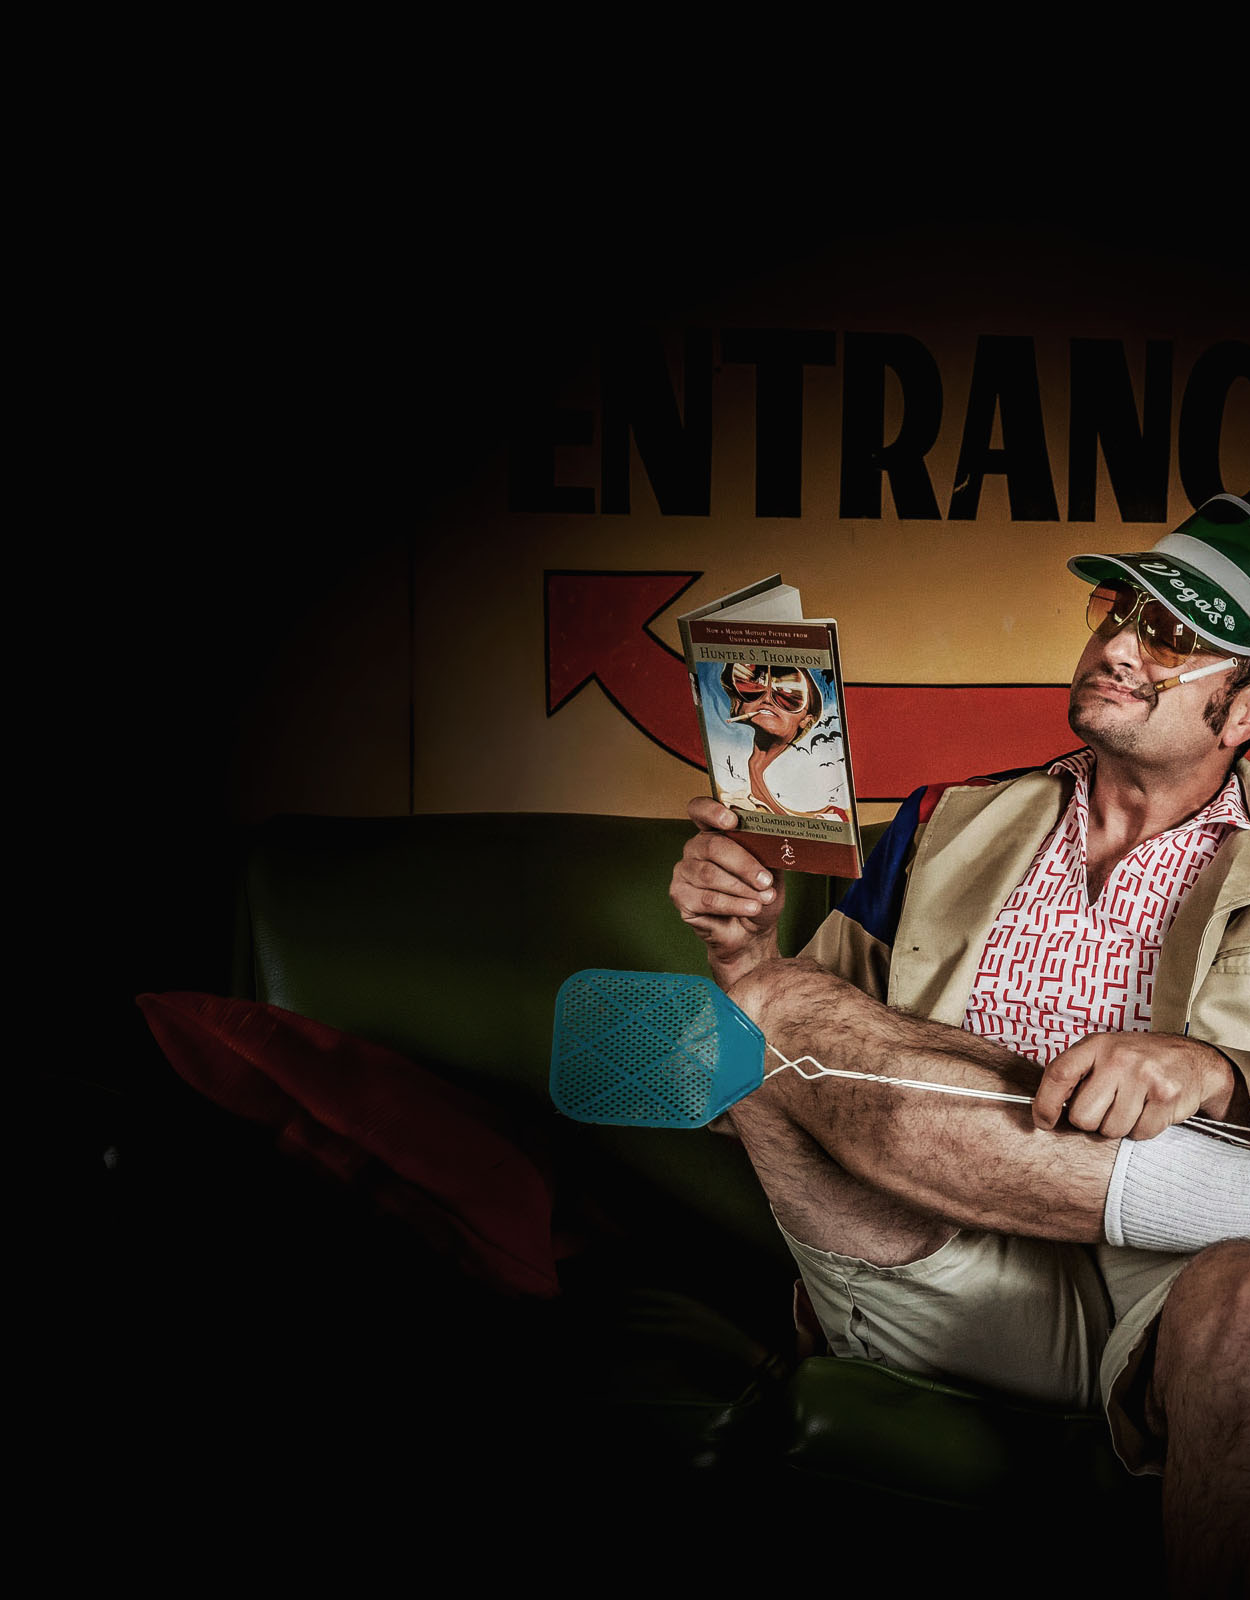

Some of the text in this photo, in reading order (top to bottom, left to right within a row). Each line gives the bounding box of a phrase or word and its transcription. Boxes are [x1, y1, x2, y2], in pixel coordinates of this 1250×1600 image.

[1139, 562, 1223, 625] Vegas
[729, 636, 787, 645] UNIVERSAL PICTURES
[768, 630, 791, 638] PICTURE
[700, 647, 821, 665] HUNTER S. THOMPSON
[756, 825, 774, 833] OTHER
[776, 828, 804, 837] AMERICAN
[805, 831, 828, 839] STORIES
[761, 815, 795, 827] LOATHING
[807, 820, 820, 830] LAS
[821, 822, 843, 833] VEGAS
